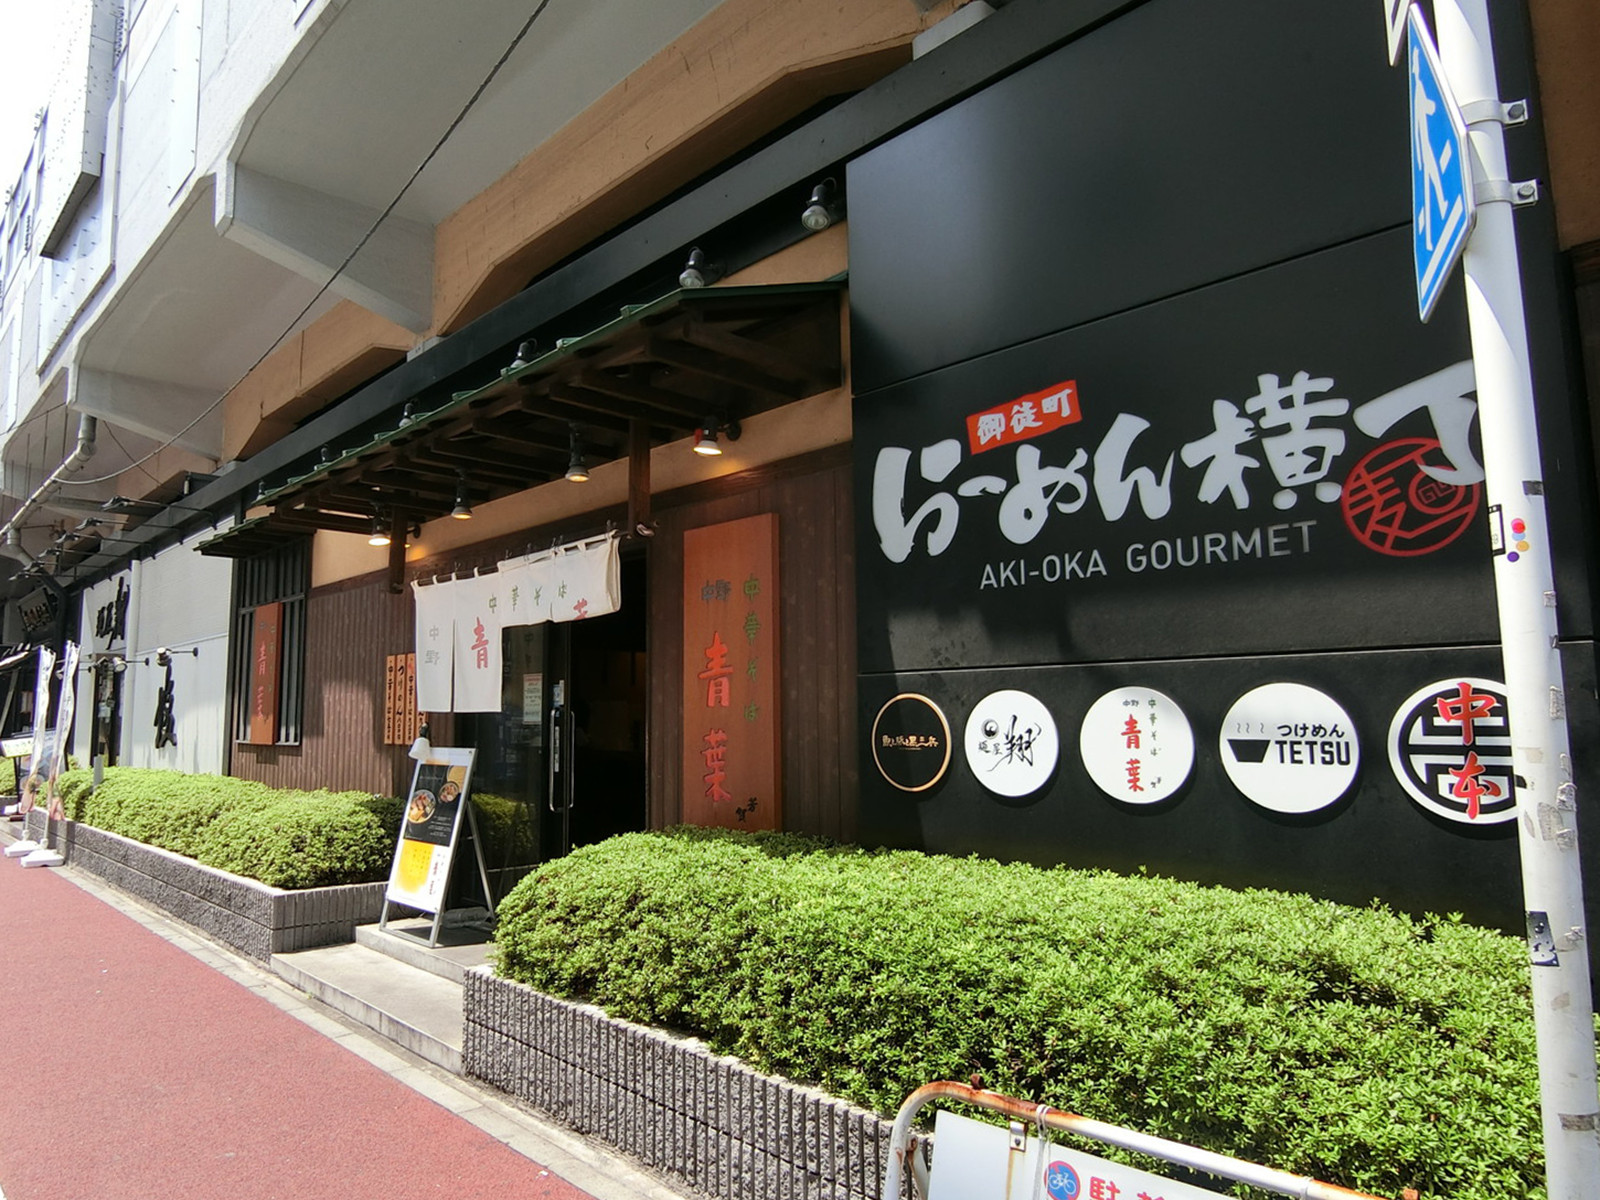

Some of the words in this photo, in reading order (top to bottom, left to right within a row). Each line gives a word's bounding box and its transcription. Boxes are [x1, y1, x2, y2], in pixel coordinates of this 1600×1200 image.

[977, 388, 1073, 446] 御徒町
[873, 360, 1485, 563] らーめん横丁
[979, 549, 1107, 590] AKI-OKA
[1126, 520, 1317, 573] GOURMET
[698, 631, 734, 803] 青葉
[1121, 713, 1144, 792] 青葉
[1275, 740, 1351, 766] TETSU
[1276, 723, 1345, 738] つけめん
[1436, 681, 1502, 820] 中本
